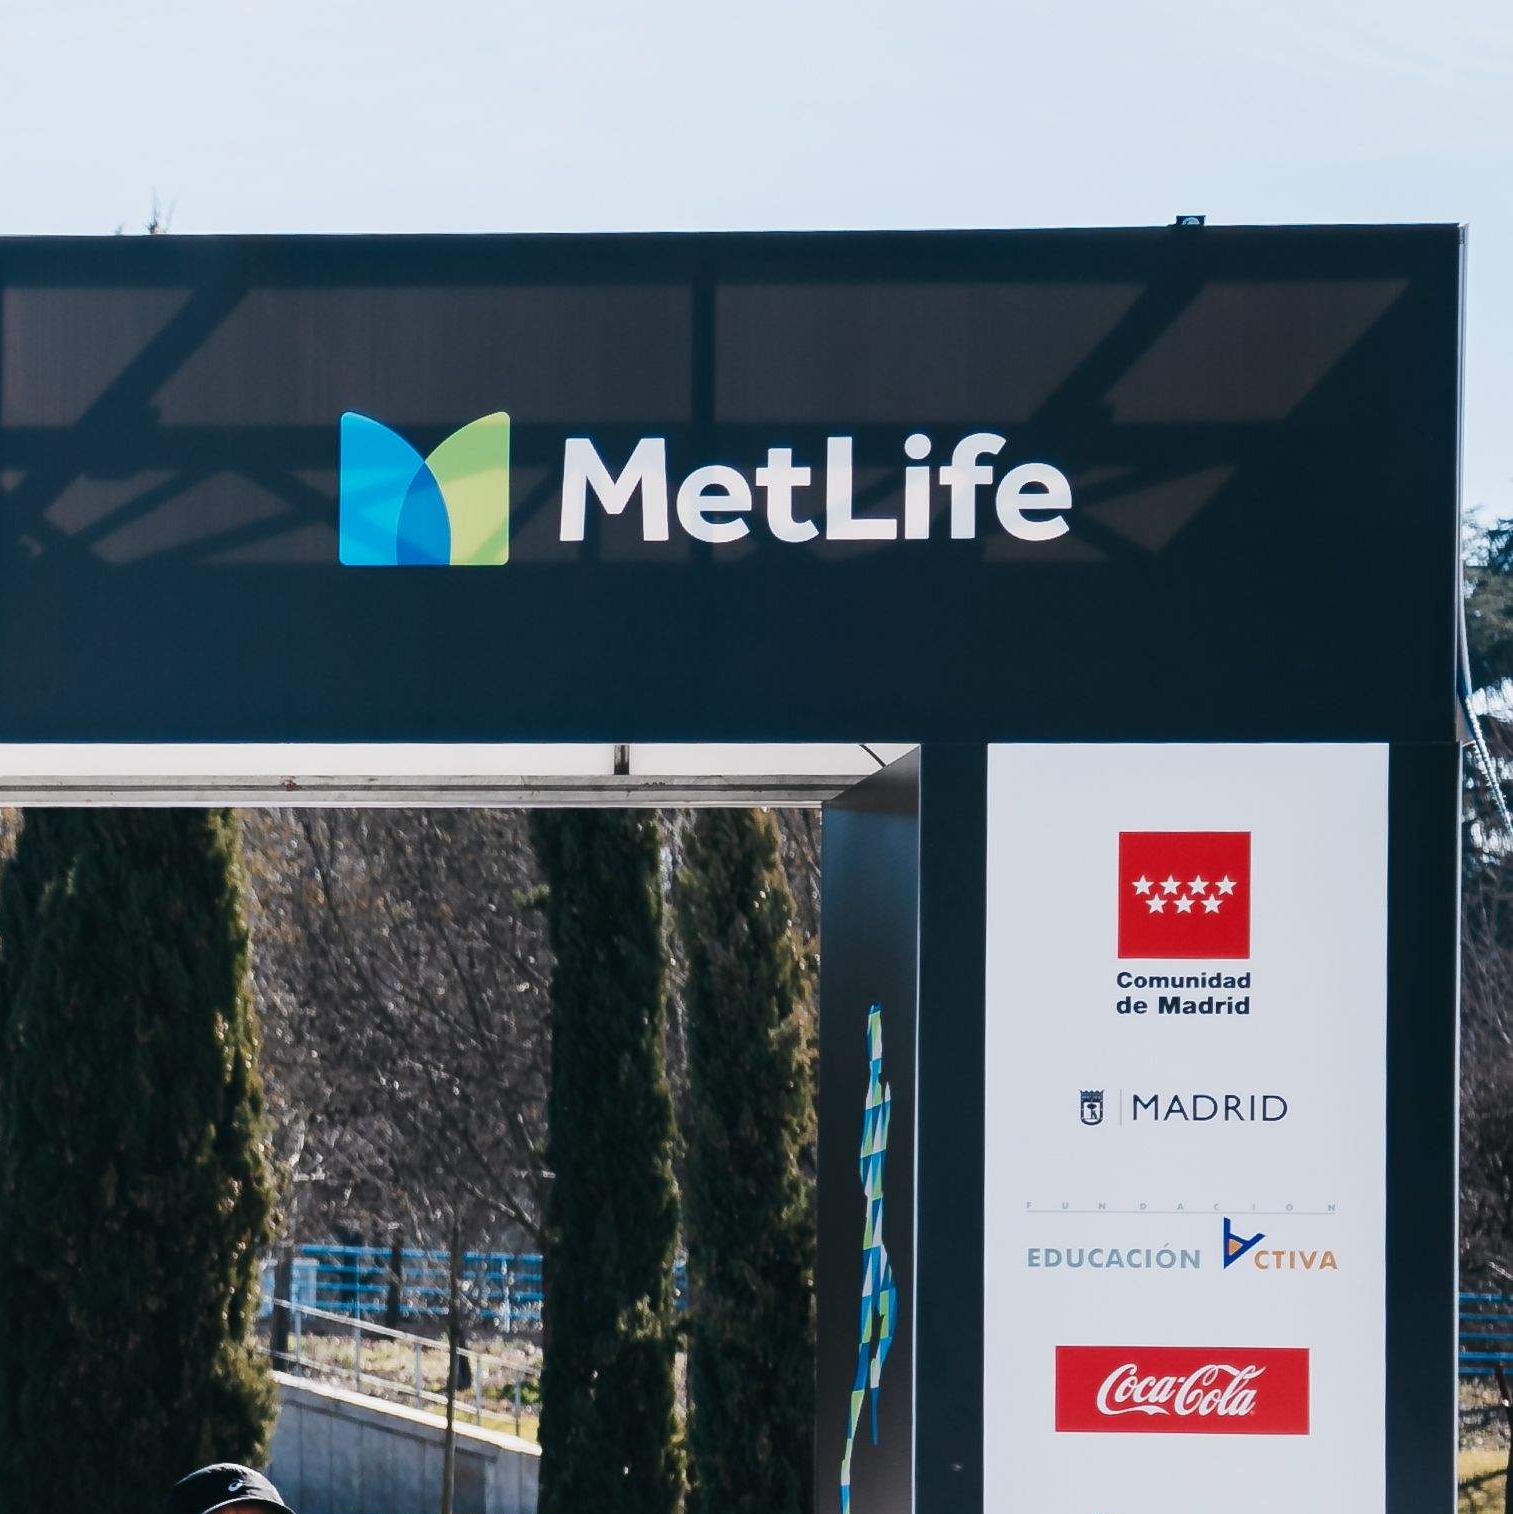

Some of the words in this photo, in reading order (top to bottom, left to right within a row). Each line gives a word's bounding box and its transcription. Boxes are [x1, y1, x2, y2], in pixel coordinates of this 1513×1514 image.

[559, 433, 1073, 543] MetLife
[1116, 972, 1252, 989] Comunidad
[1116, 996, 1148, 1015] de
[1158, 996, 1251, 1015] Madrid
[1132, 1094, 1288, 1122] MADRID
[1027, 1243, 1202, 1270] EDUCACIÓN
